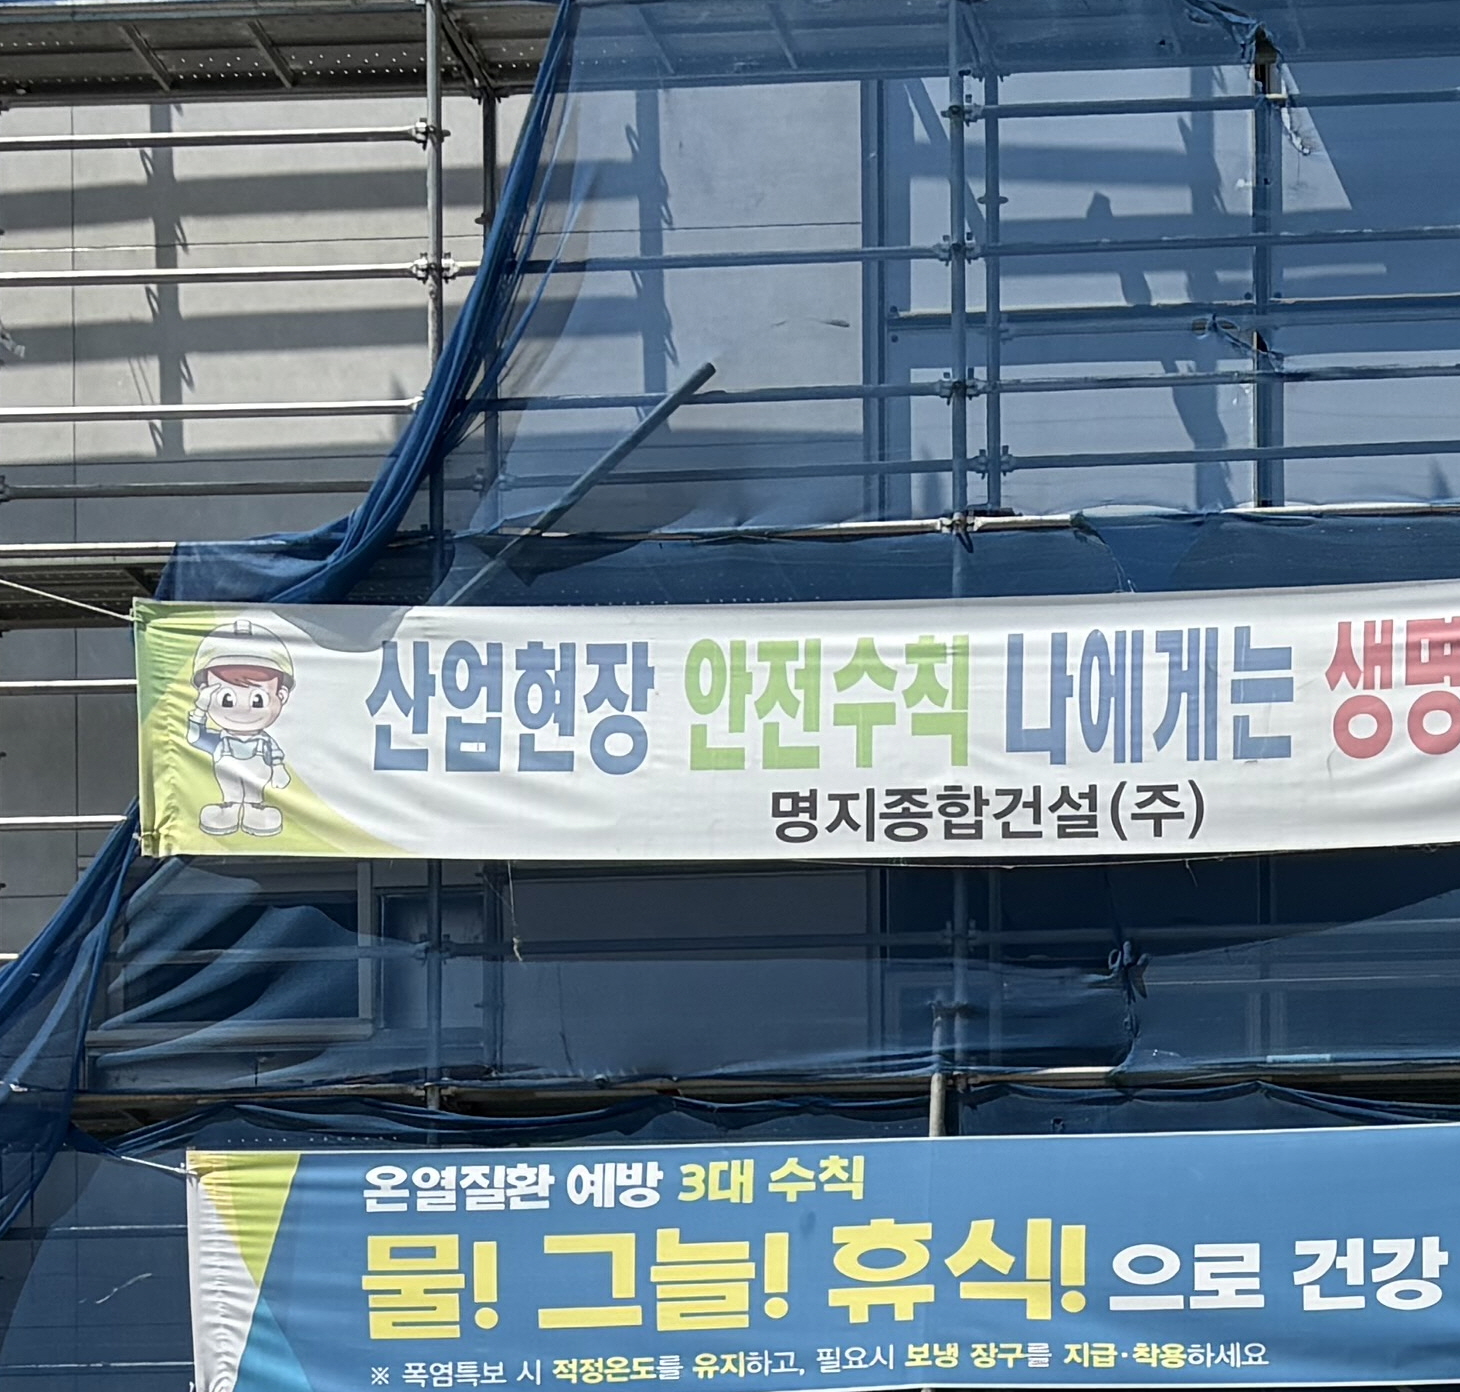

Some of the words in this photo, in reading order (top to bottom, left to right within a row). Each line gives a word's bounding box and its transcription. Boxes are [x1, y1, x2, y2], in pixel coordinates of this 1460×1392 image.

[366, 639, 655, 774] 산업현장
[685, 635, 970, 771] 안전수칙
[1005, 626, 1293, 765] 나에게는
[770, 780, 1206, 843] 명지종합건설(주)
[362, 1163, 556, 1214] 온열질환
[566, 1161, 664, 1210] 예방
[678, 1158, 755, 1205] 3대
[768, 1155, 867, 1204] 수칙
[362, 1234, 500, 1341] 물!
[538, 1227, 790, 1333] 그늘!
[828, 1217, 1087, 1325] 휴식!
[1109, 1242, 1266, 1312] 으로
[1293, 1236, 1450, 1312] 건강
[402, 1361, 507, 1389] 폭염특보
[516, 1359, 542, 1386] 시
[552, 1355, 684, 1385] 적정온도를
[692, 1350, 806, 1380] 유지하고,
[816, 1343, 895, 1374] 필요시
[904, 1342, 960, 1370] 보냉
[970, 1342, 1053, 1370] 장구를
